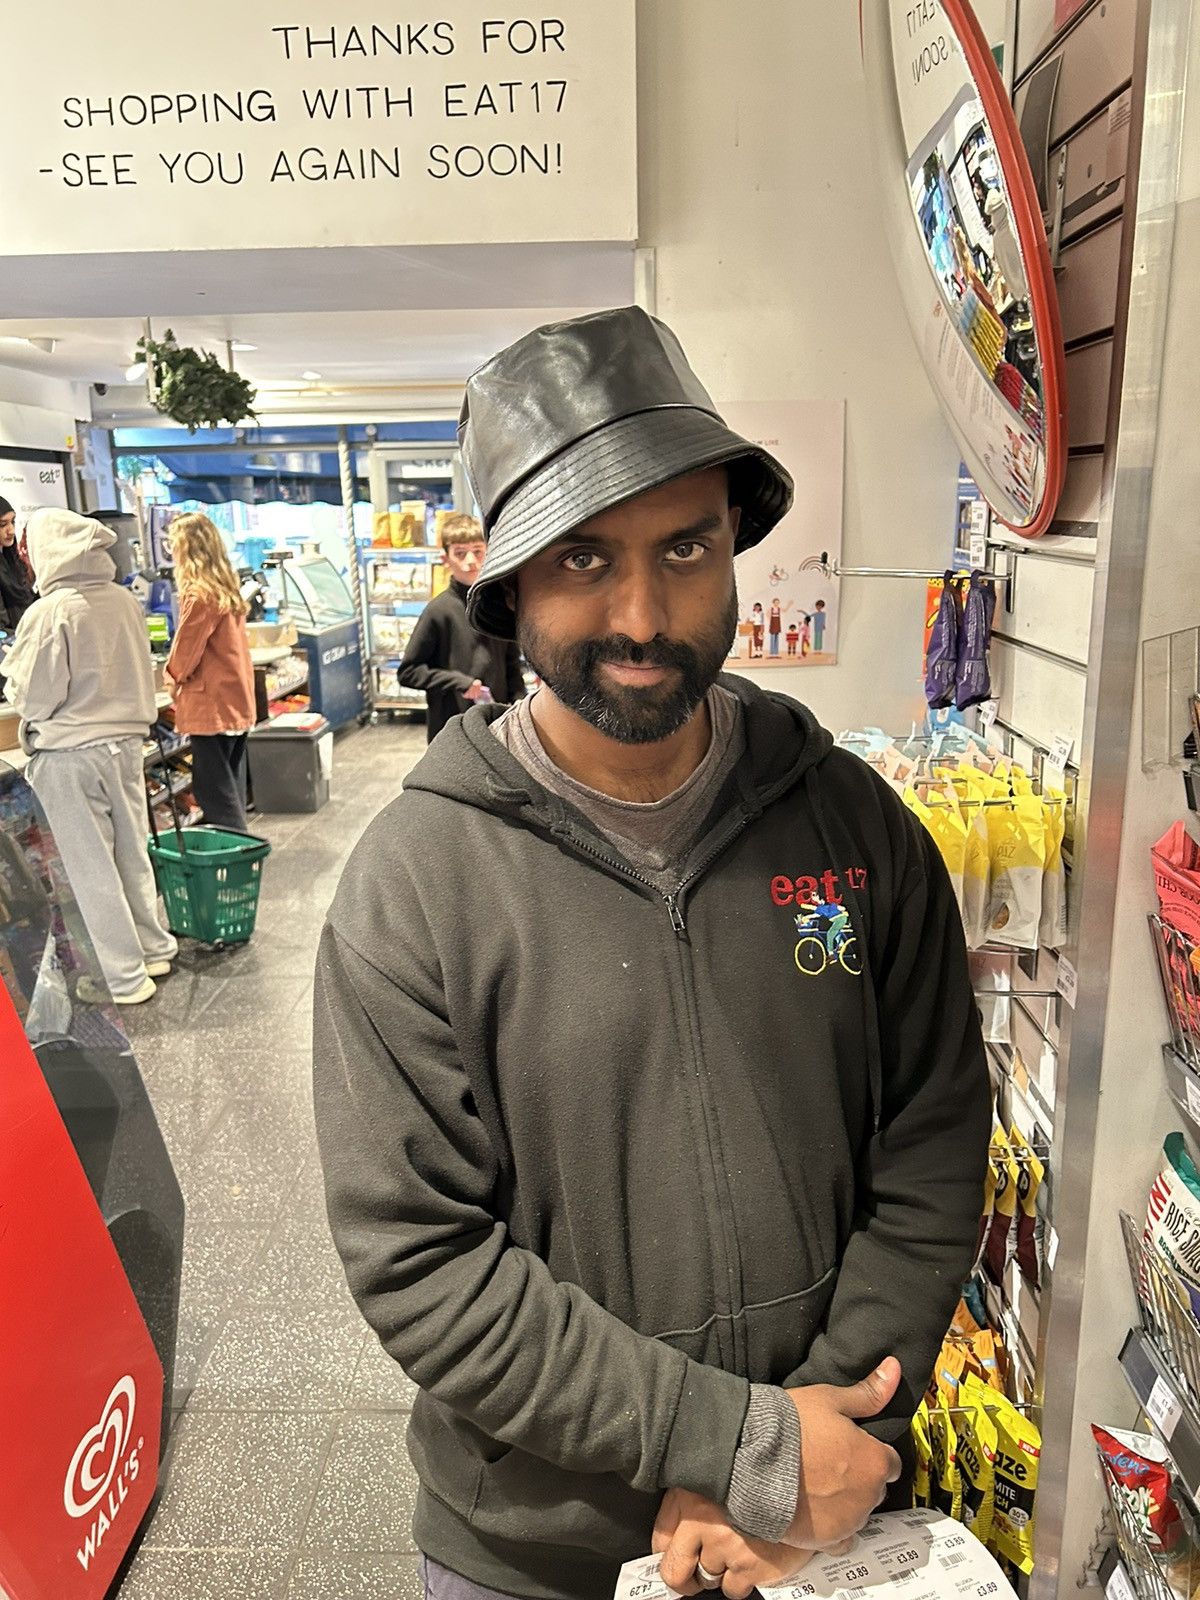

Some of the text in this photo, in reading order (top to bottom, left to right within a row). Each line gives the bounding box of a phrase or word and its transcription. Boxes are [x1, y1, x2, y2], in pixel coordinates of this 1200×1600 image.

[272, 20, 564, 59] THANKS FOR
[64, 81, 566, 127] SHOPPING WITH EAT17
[159, 152, 243, 184] YOU
[271, 148, 399, 181] AGAIN
[428, 144, 560, 178] SOON!
[1163, 1202, 1190, 1242] RICE
[76, 1448, 139, 1571] WALL'S
[944, 1536, 966, 1549] £3.89
[896, 1549, 919, 1565] £3.89
[845, 1565, 869, 1581] £3.89
[629, 1581, 652, 1597] £4.29
[790, 1583, 816, 1600] £3.89
[976, 1581, 998, 1597] £3.89
